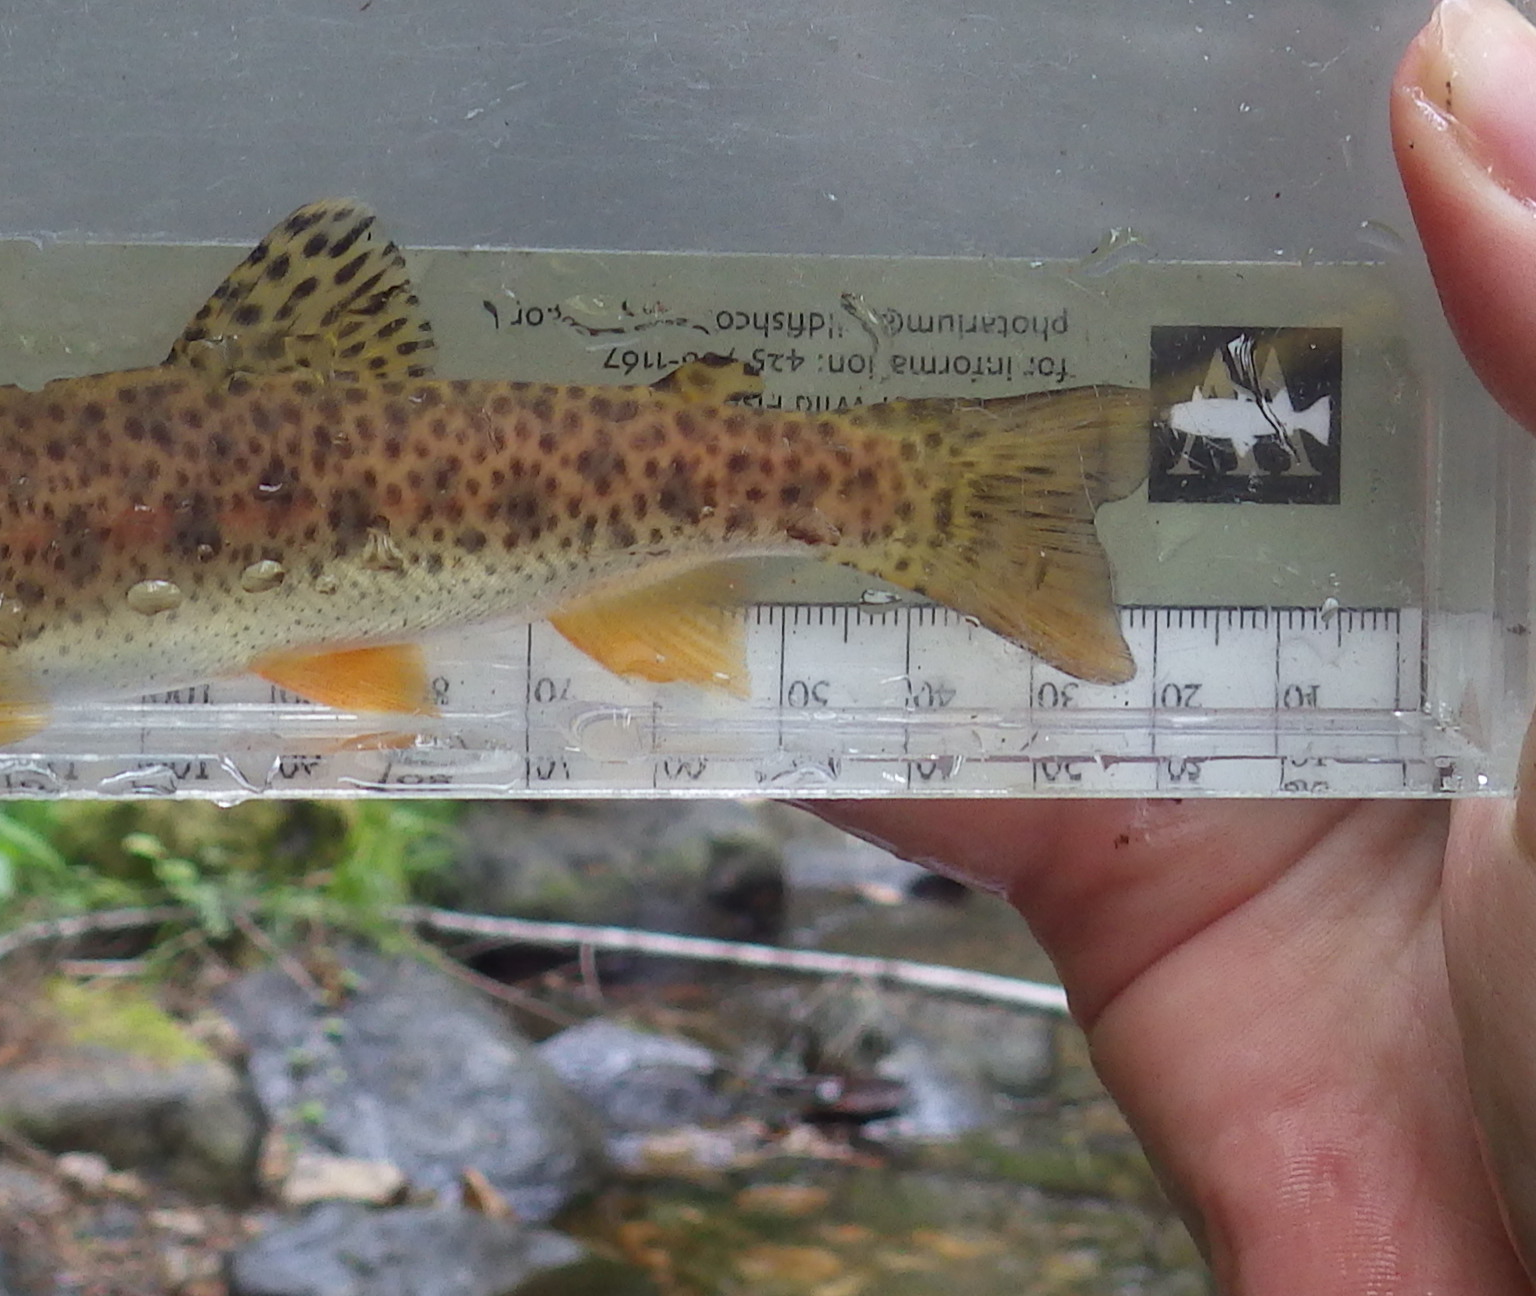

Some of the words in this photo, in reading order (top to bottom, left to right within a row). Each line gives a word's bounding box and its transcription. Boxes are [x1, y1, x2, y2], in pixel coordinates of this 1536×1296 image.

[818, 354, 1013, 385] informaion:
[1023, 356, 1071, 385] for
[432, 676, 450, 706] 8
